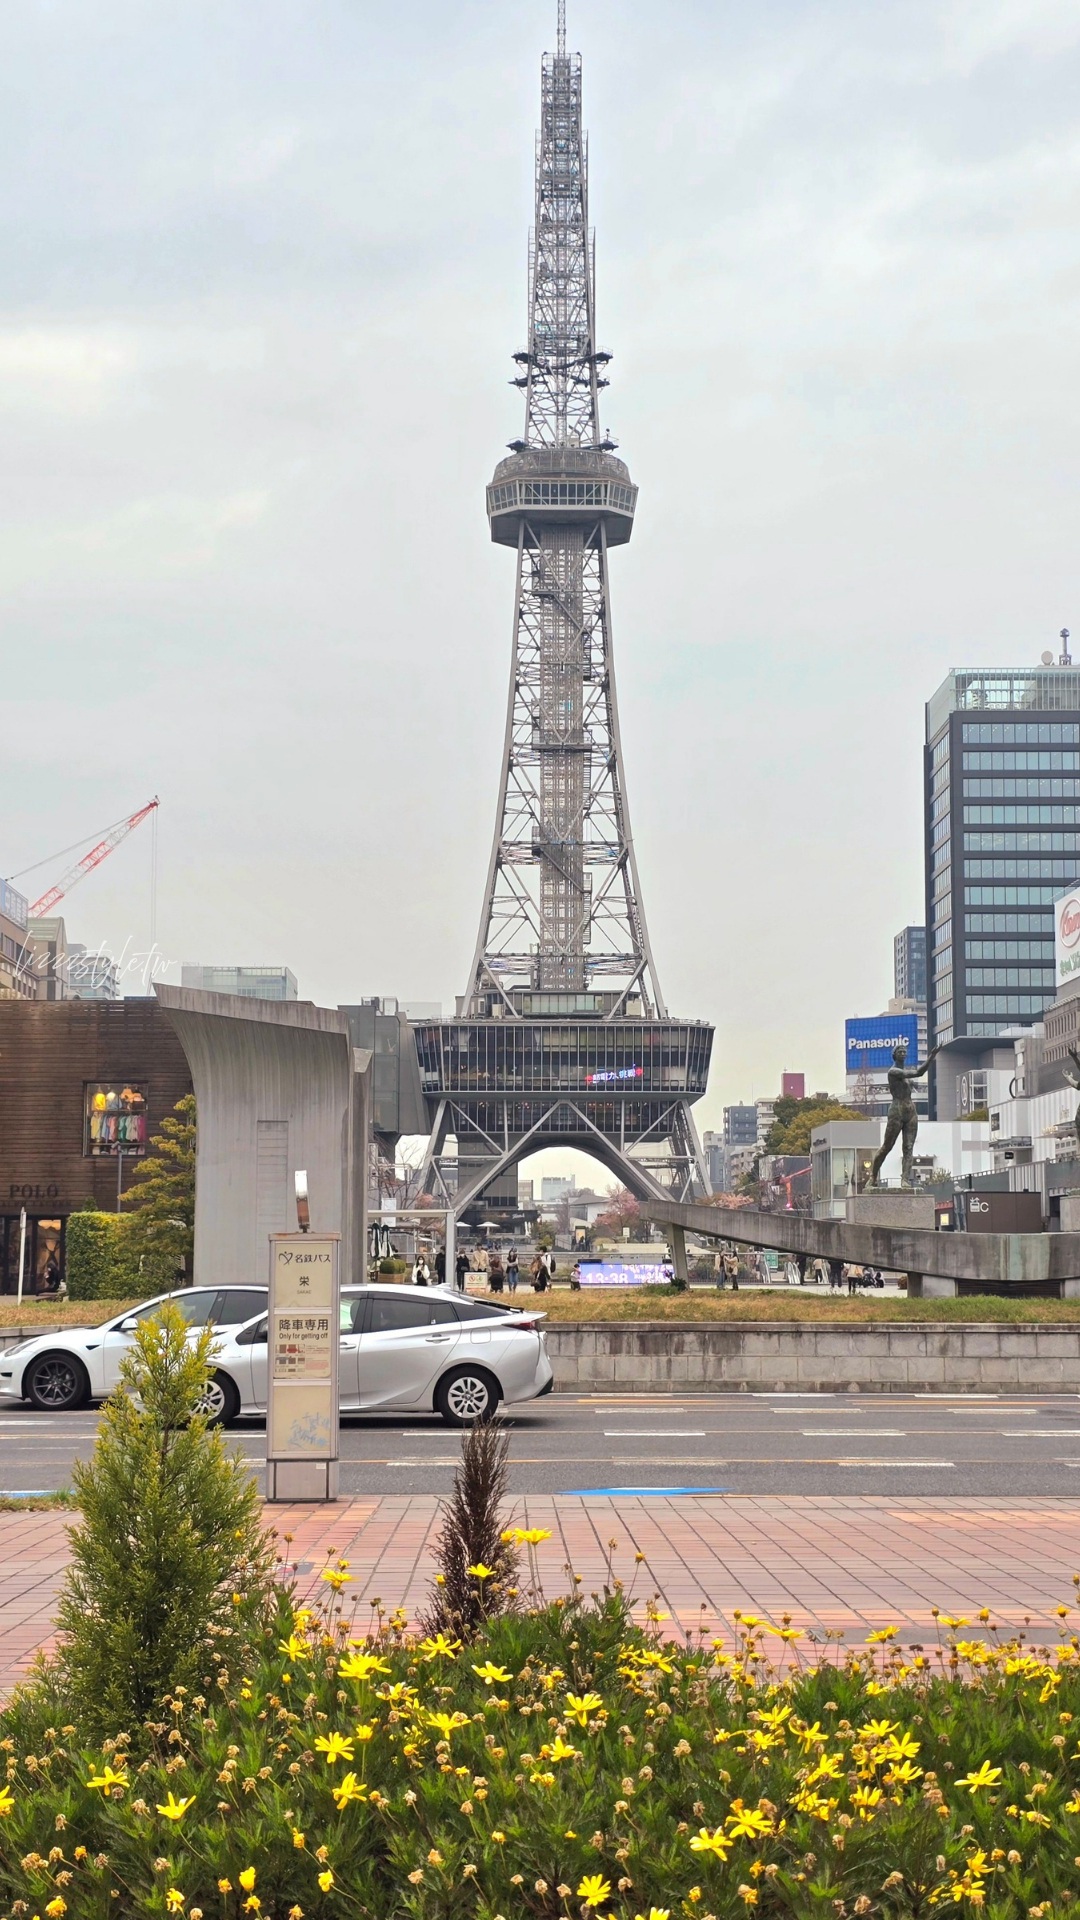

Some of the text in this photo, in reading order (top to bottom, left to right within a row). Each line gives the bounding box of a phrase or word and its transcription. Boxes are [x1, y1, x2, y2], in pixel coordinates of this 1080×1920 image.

[848, 1035, 909, 1050] Panasonic
[9, 1183, 58, 1199] POLO
[295, 1254, 331, 1263] 名鉄バス
[299, 1276, 310, 1287] 栄
[279, 1318, 328, 1331] 降車専用
[279, 1332, 291, 1340] Only
[300, 1333, 320, 1341] getting
